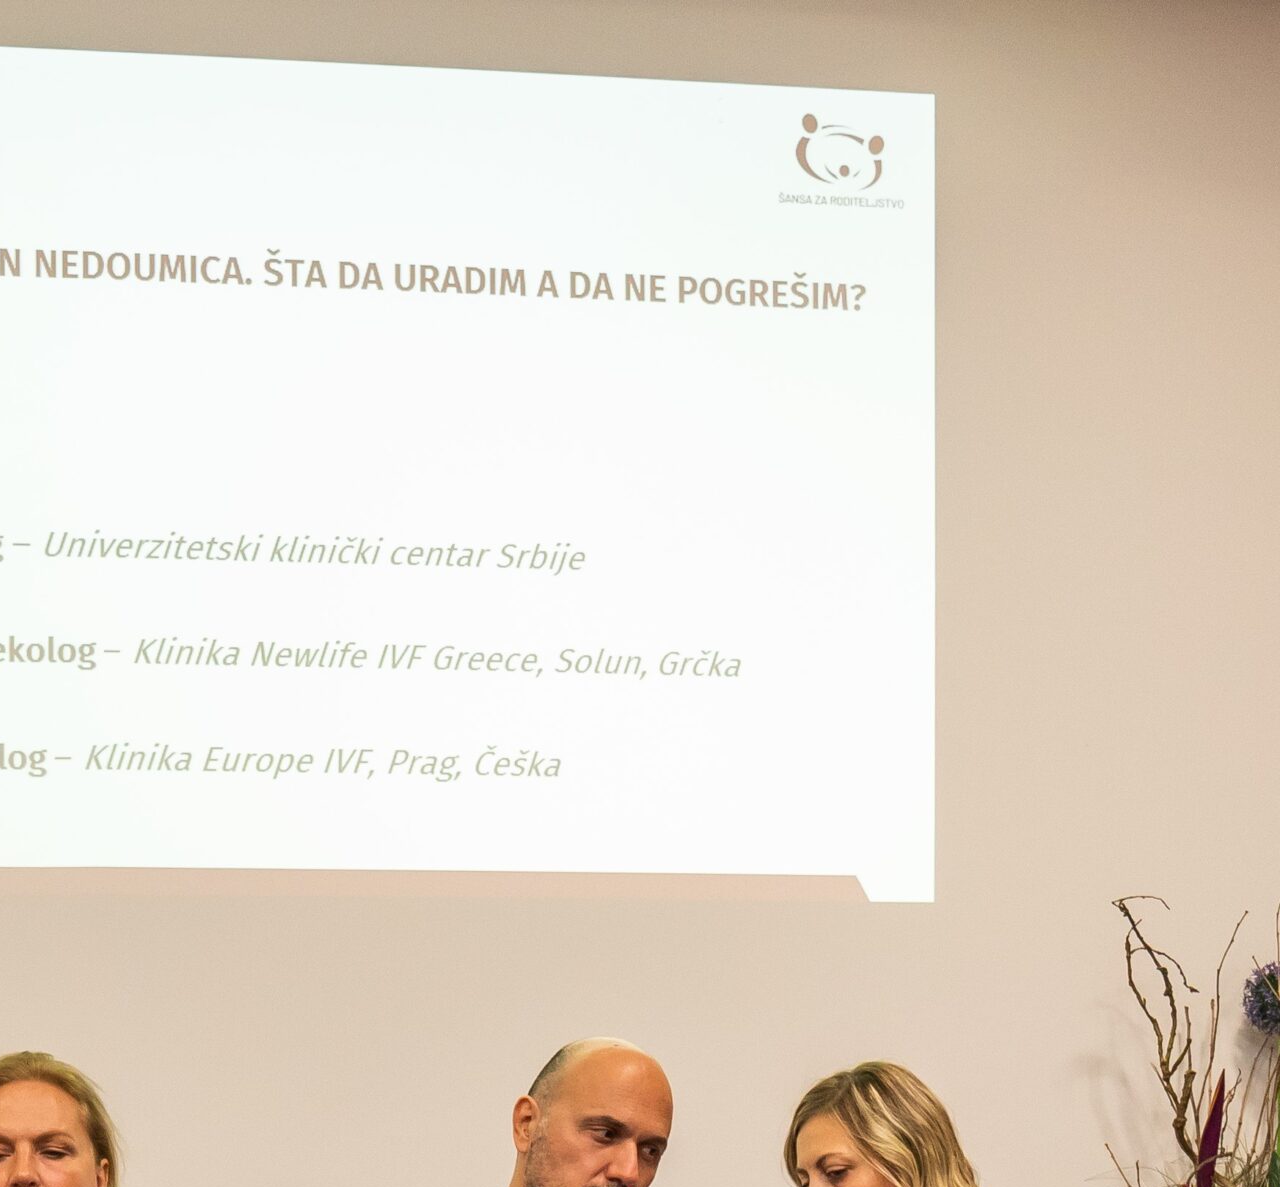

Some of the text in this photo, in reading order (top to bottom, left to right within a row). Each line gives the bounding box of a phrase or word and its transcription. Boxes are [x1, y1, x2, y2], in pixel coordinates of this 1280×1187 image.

[814, 195, 828, 205] ZA
[35, 249, 252, 285] NEDOUMICA.
[264, 248, 327, 288] ŠTA
[339, 261, 384, 290] DA
[394, 264, 526, 296] URADIM
[537, 270, 559, 298] A
[570, 271, 614, 300] DA
[625, 273, 666, 303] NE
[678, 272, 866, 311] POGREŠIM?
[43, 529, 261, 562] Univerzitetski
[269, 533, 384, 565] klinički
[389, 544, 491, 568] centar
[496, 543, 586, 577] Srbije
[133, 637, 241, 666] Klinika
[250, 640, 368, 669] Newlife
[377, 644, 427, 670] IVF
[433, 646, 544, 678] Greece,
[554, 647, 647, 681] Solun,
[658, 649, 742, 678] Grčka
[84, 743, 193, 772] Klinika
[202, 747, 315, 780] Europe
[323, 748, 375, 780] IVF,
[387, 749, 462, 783] Prag,
[475, 746, 562, 778] Češka
